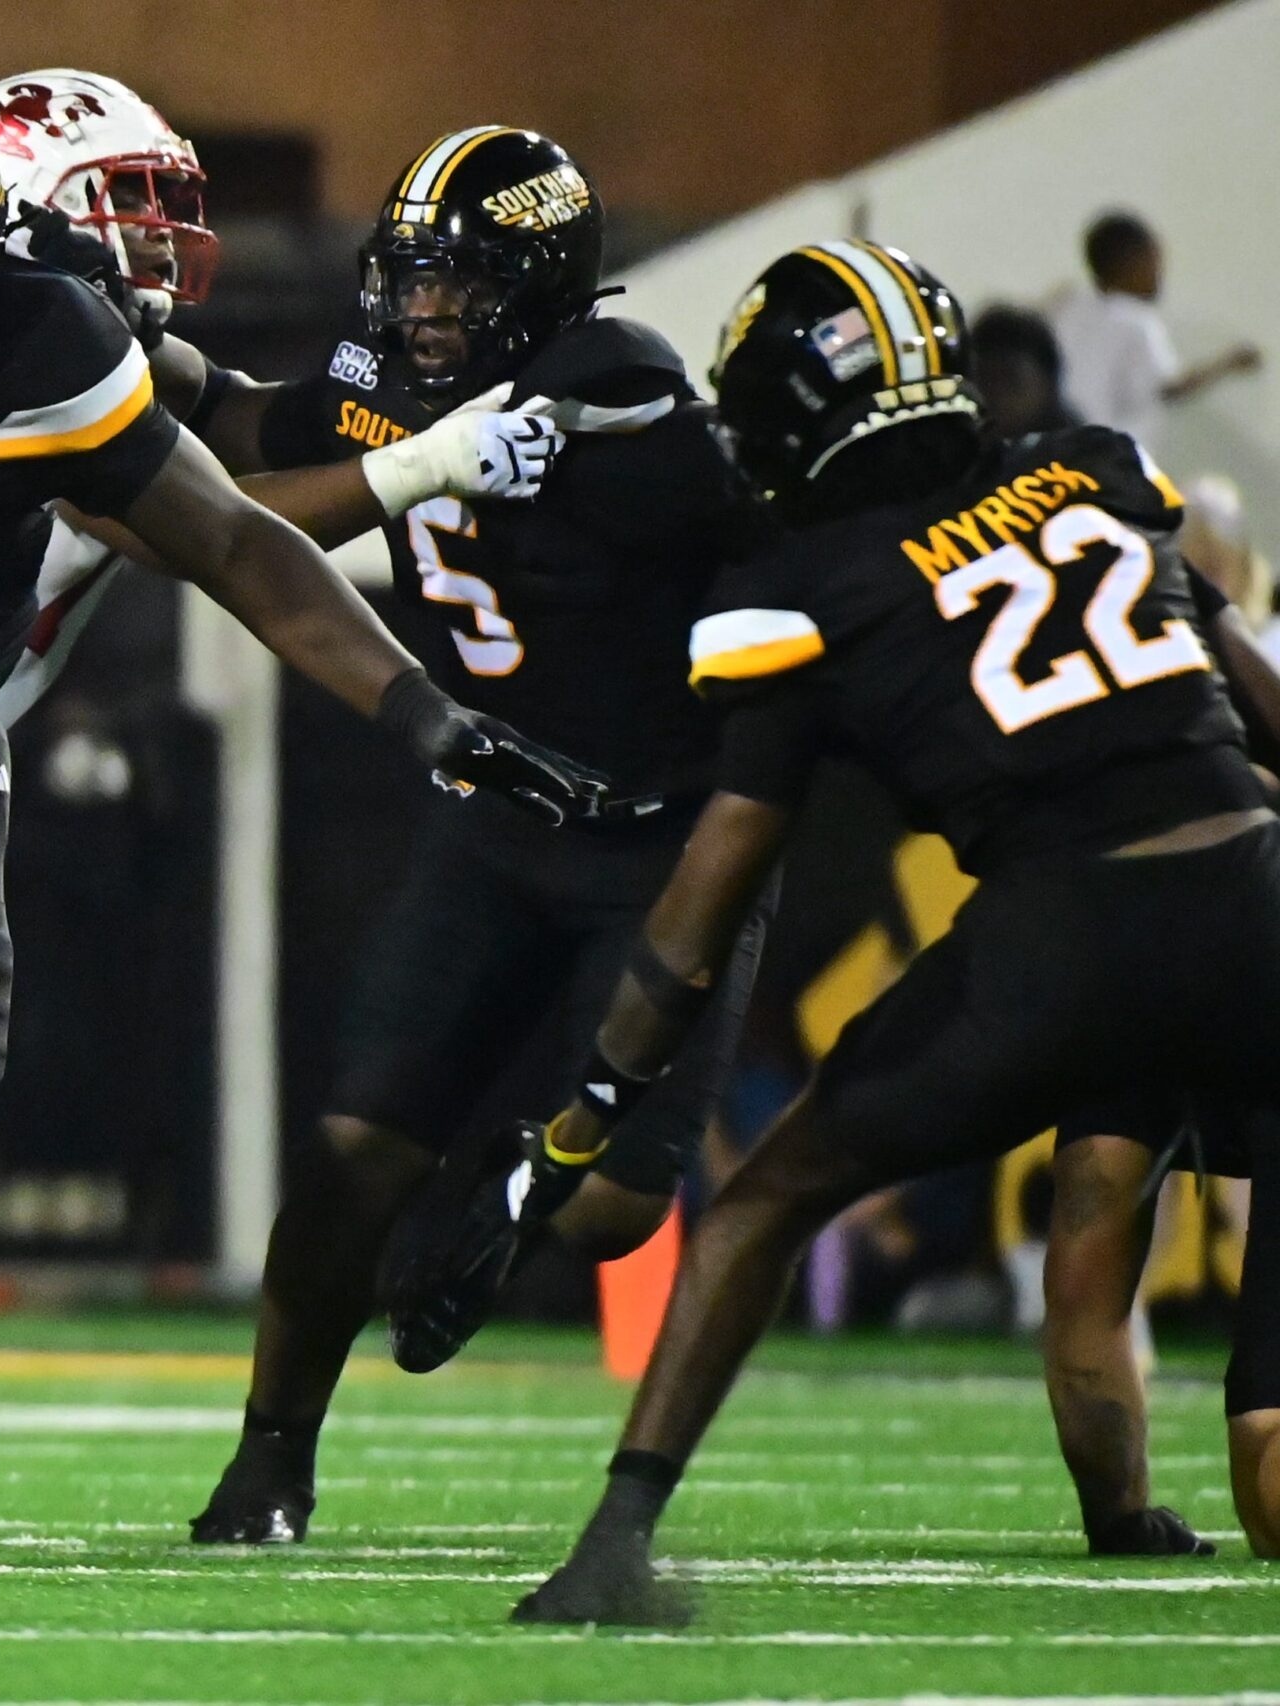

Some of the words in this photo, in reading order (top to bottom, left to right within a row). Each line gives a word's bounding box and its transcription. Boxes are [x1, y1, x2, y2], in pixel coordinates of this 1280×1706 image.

[335, 400, 413, 448] SOUT
[406, 496, 525, 676] 5
[934, 503, 1211, 735] 22
